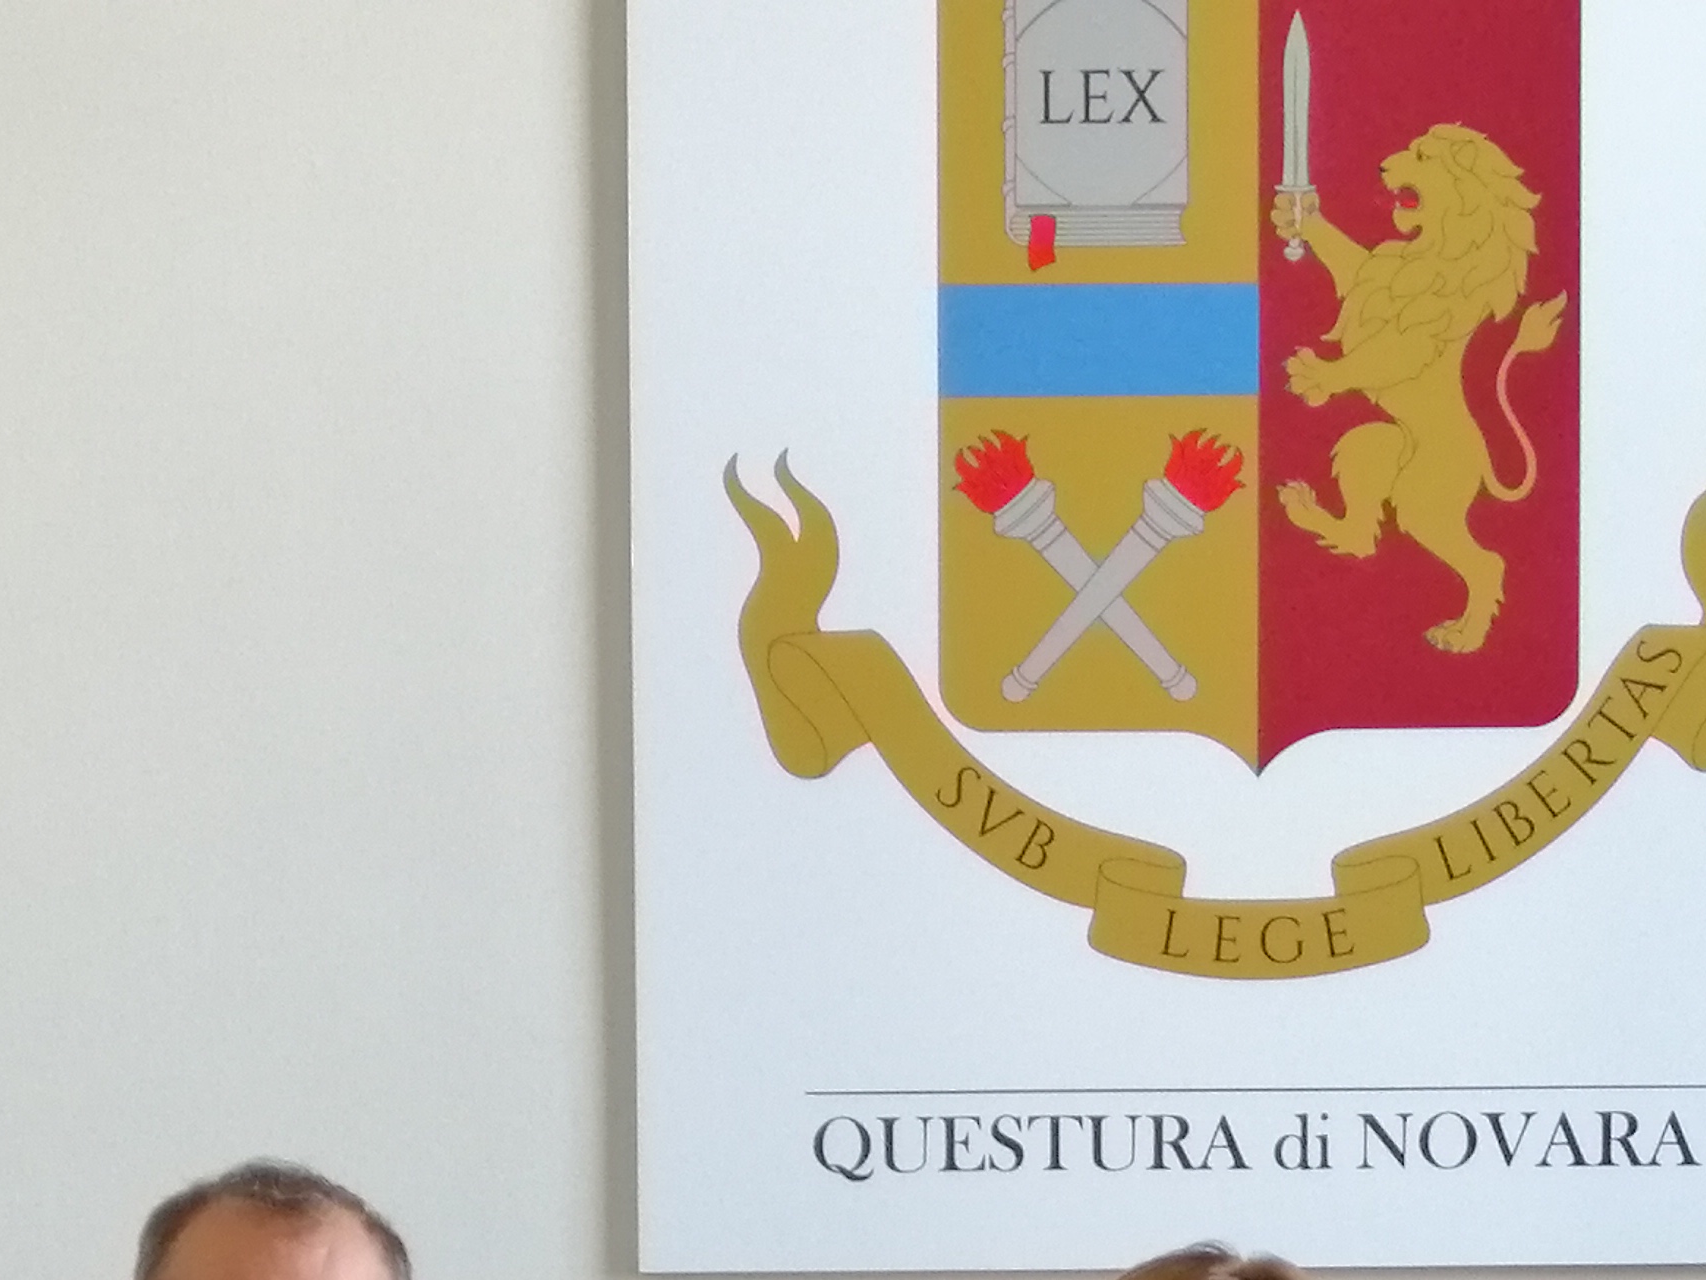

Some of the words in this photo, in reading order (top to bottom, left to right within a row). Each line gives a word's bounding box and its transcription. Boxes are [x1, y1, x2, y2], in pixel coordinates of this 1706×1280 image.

[1040, 70, 1165, 125] LEX
[936, 766, 1057, 871] SVB
[1160, 909, 1355, 966] LEGE
[1433, 638, 1684, 882] LIBERTAS
[812, 1112, 1251, 1182] QUESTURA
[1273, 1110, 1331, 1171] di
[1357, 1109, 1701, 1171] NOVARA
